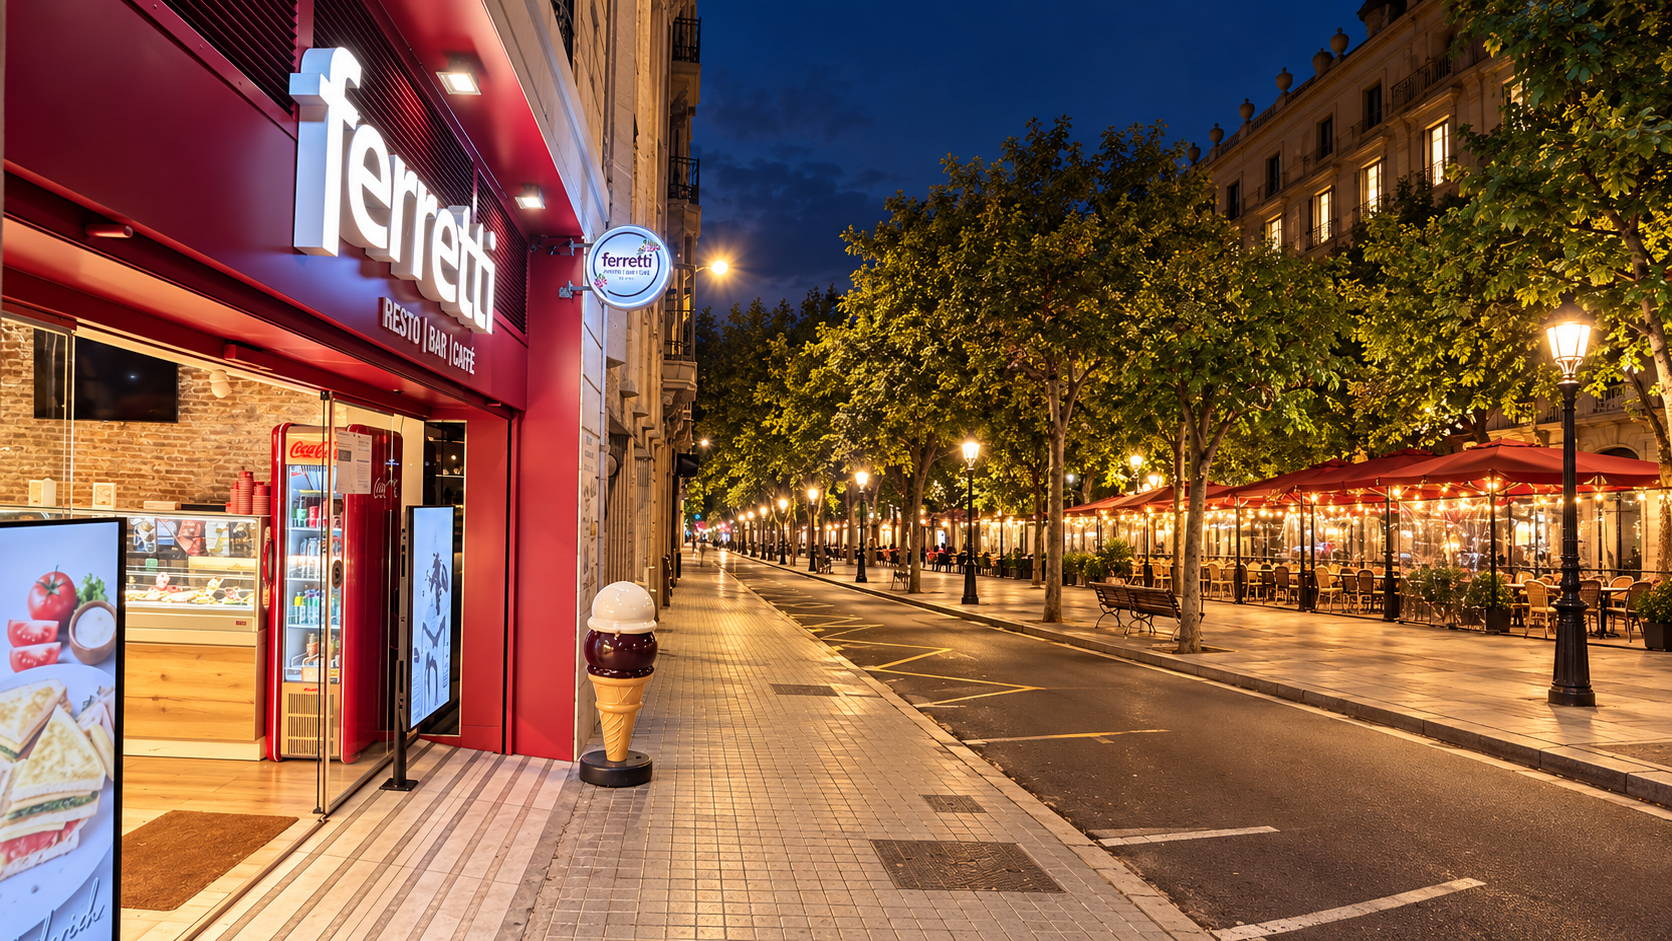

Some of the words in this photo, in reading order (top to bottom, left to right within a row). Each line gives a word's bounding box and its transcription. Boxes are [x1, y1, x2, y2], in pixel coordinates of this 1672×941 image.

[292, 47, 496, 335] ferretti
[601, 252, 652, 268] ferretti
[382, 297, 421, 345] RESTO
[428, 325, 447, 360] BAR
